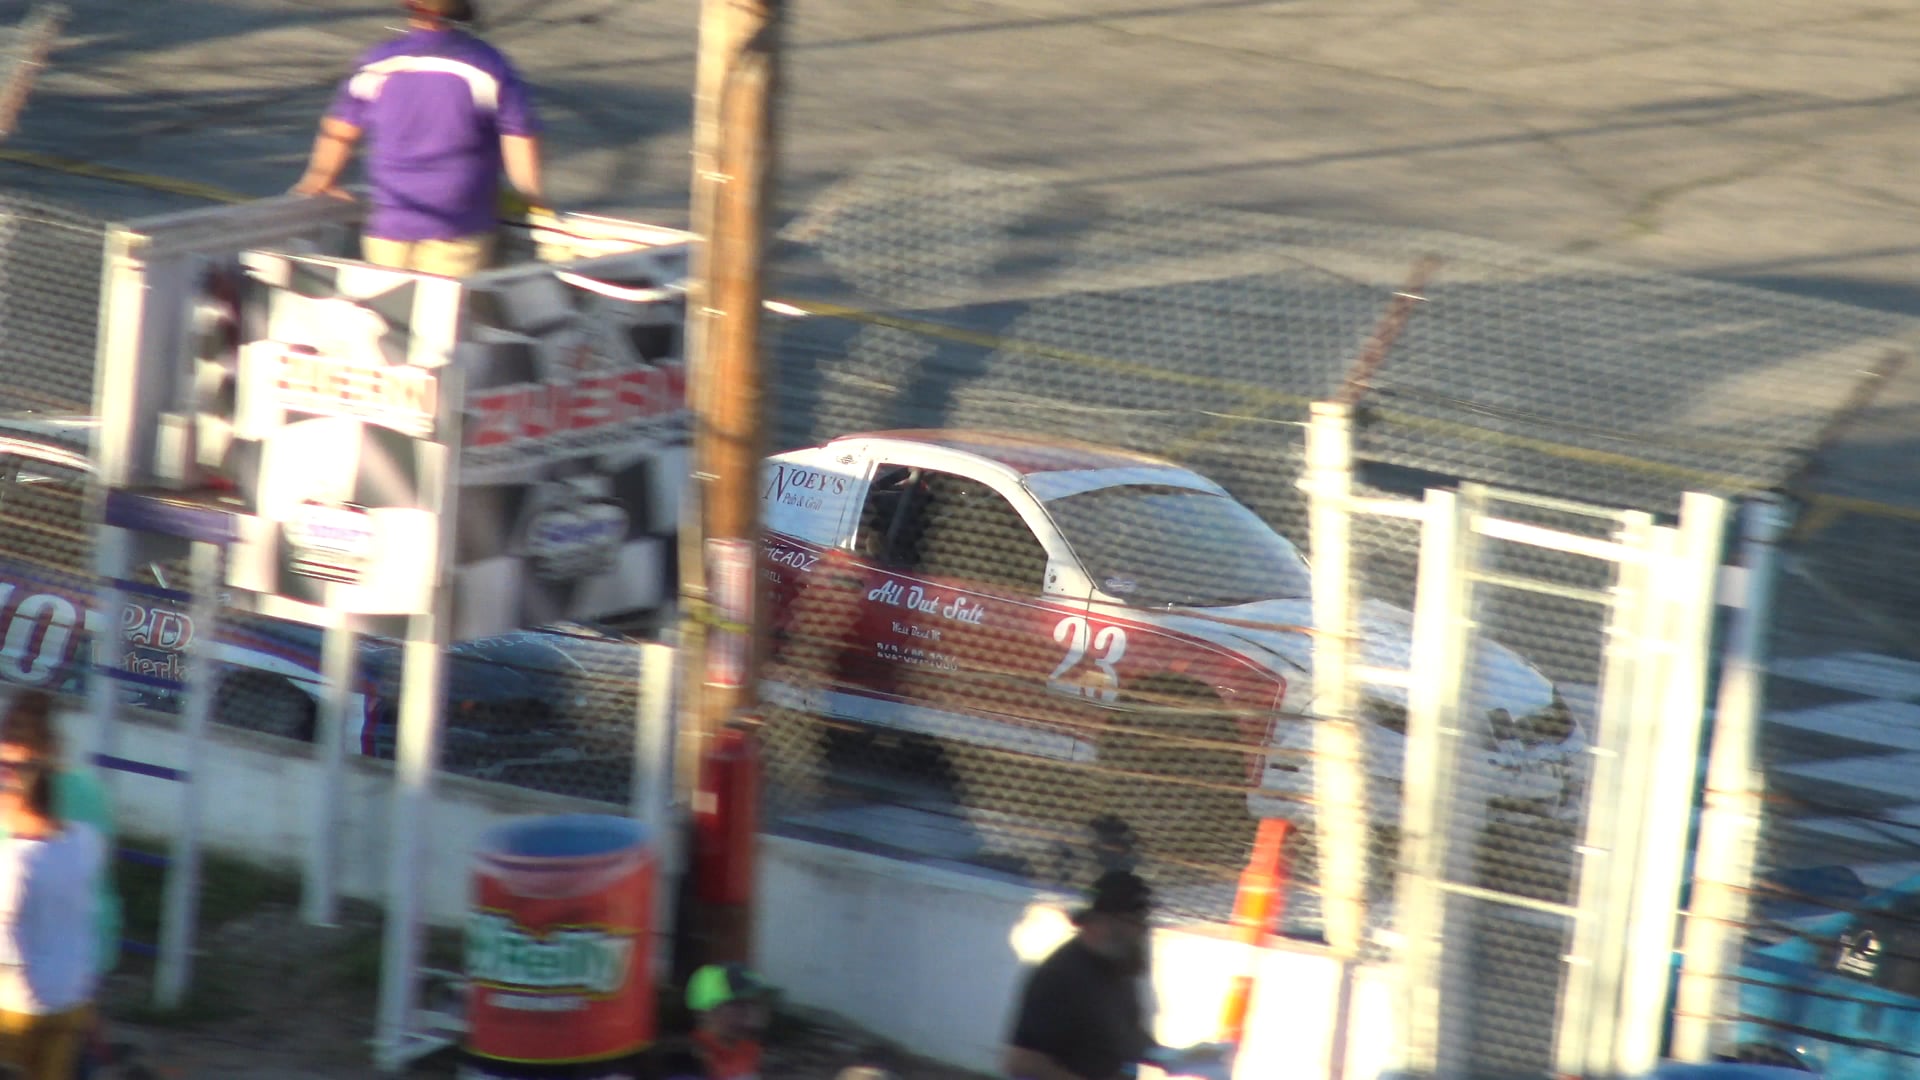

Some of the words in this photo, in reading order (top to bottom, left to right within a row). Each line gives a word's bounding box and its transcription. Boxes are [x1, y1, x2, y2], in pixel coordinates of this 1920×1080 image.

[762, 466, 846, 502] NOEY'S
[0, 582, 77, 682] 0
[868, 580, 904, 606] All
[907, 586, 939, 614] Out
[943, 597, 984, 625] Salt
[1045, 616, 1126, 702] 23
